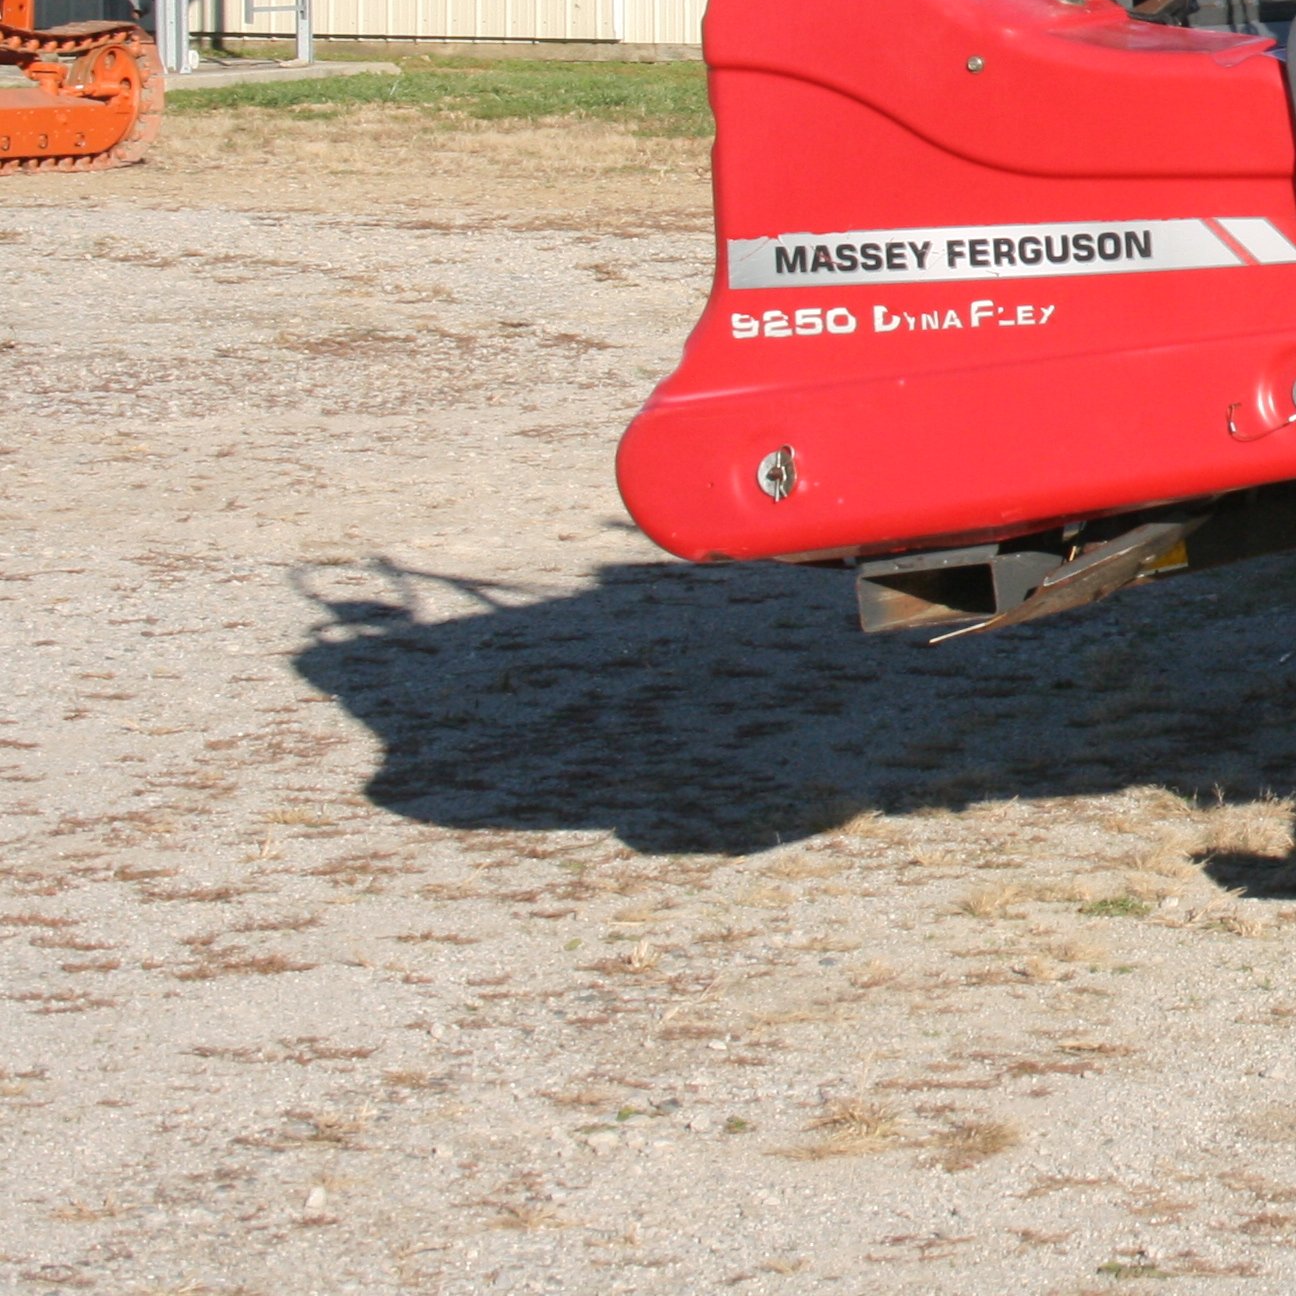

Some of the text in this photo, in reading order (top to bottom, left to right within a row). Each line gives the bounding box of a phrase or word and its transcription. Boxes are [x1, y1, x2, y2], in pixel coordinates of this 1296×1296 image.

[775, 230, 1152, 274] MASSEY FERGUSON
[731, 307, 858, 339] 9250
